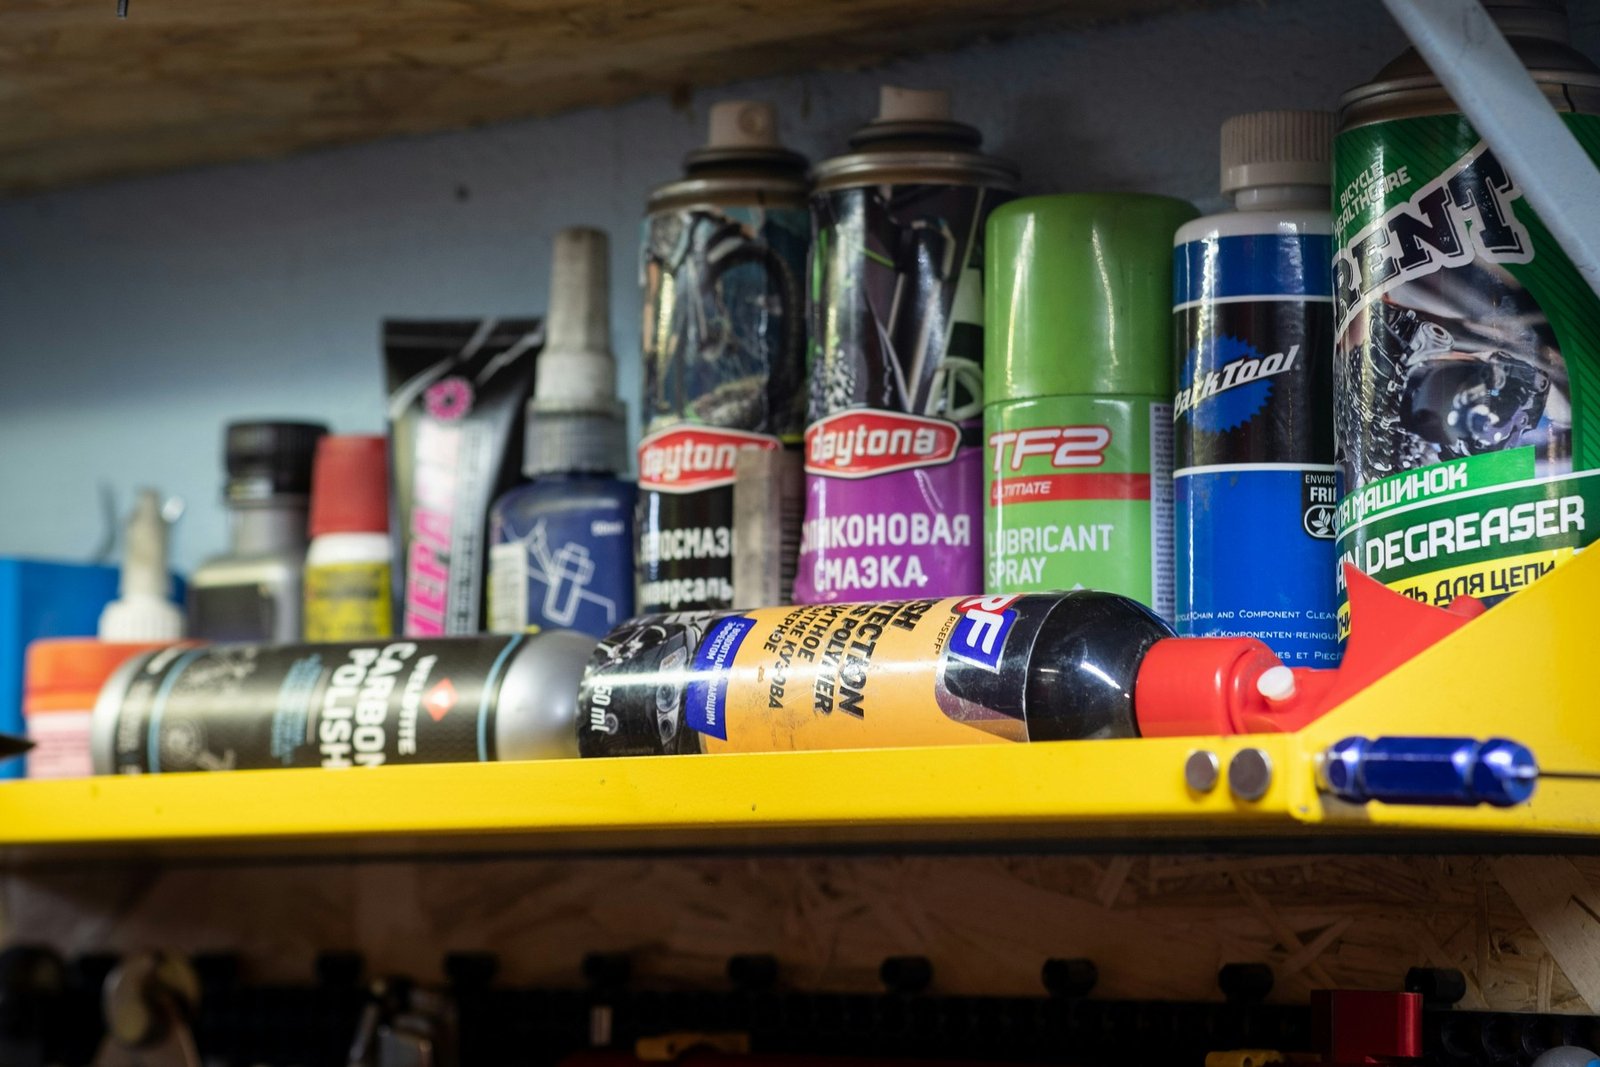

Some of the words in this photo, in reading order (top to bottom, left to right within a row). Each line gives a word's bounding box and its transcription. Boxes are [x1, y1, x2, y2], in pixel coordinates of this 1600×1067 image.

[1340, 161, 1384, 206] BICYCLE
[989, 425, 1112, 472] TF2
[1352, 462, 1468, 520] МАШИНОК
[989, 524, 1114, 558] LUBRICANT
[1366, 495, 1585, 576] DEGREASER
[814, 555, 928, 593] СМАЗКА
[989, 556, 1047, 589] SPRAY
[1217, 611, 1235, 619] AND
[1238, 609, 1301, 619] COMPONENT
[1296, 651, 1308, 660] ET
[319, 648, 380, 768] POLISH
